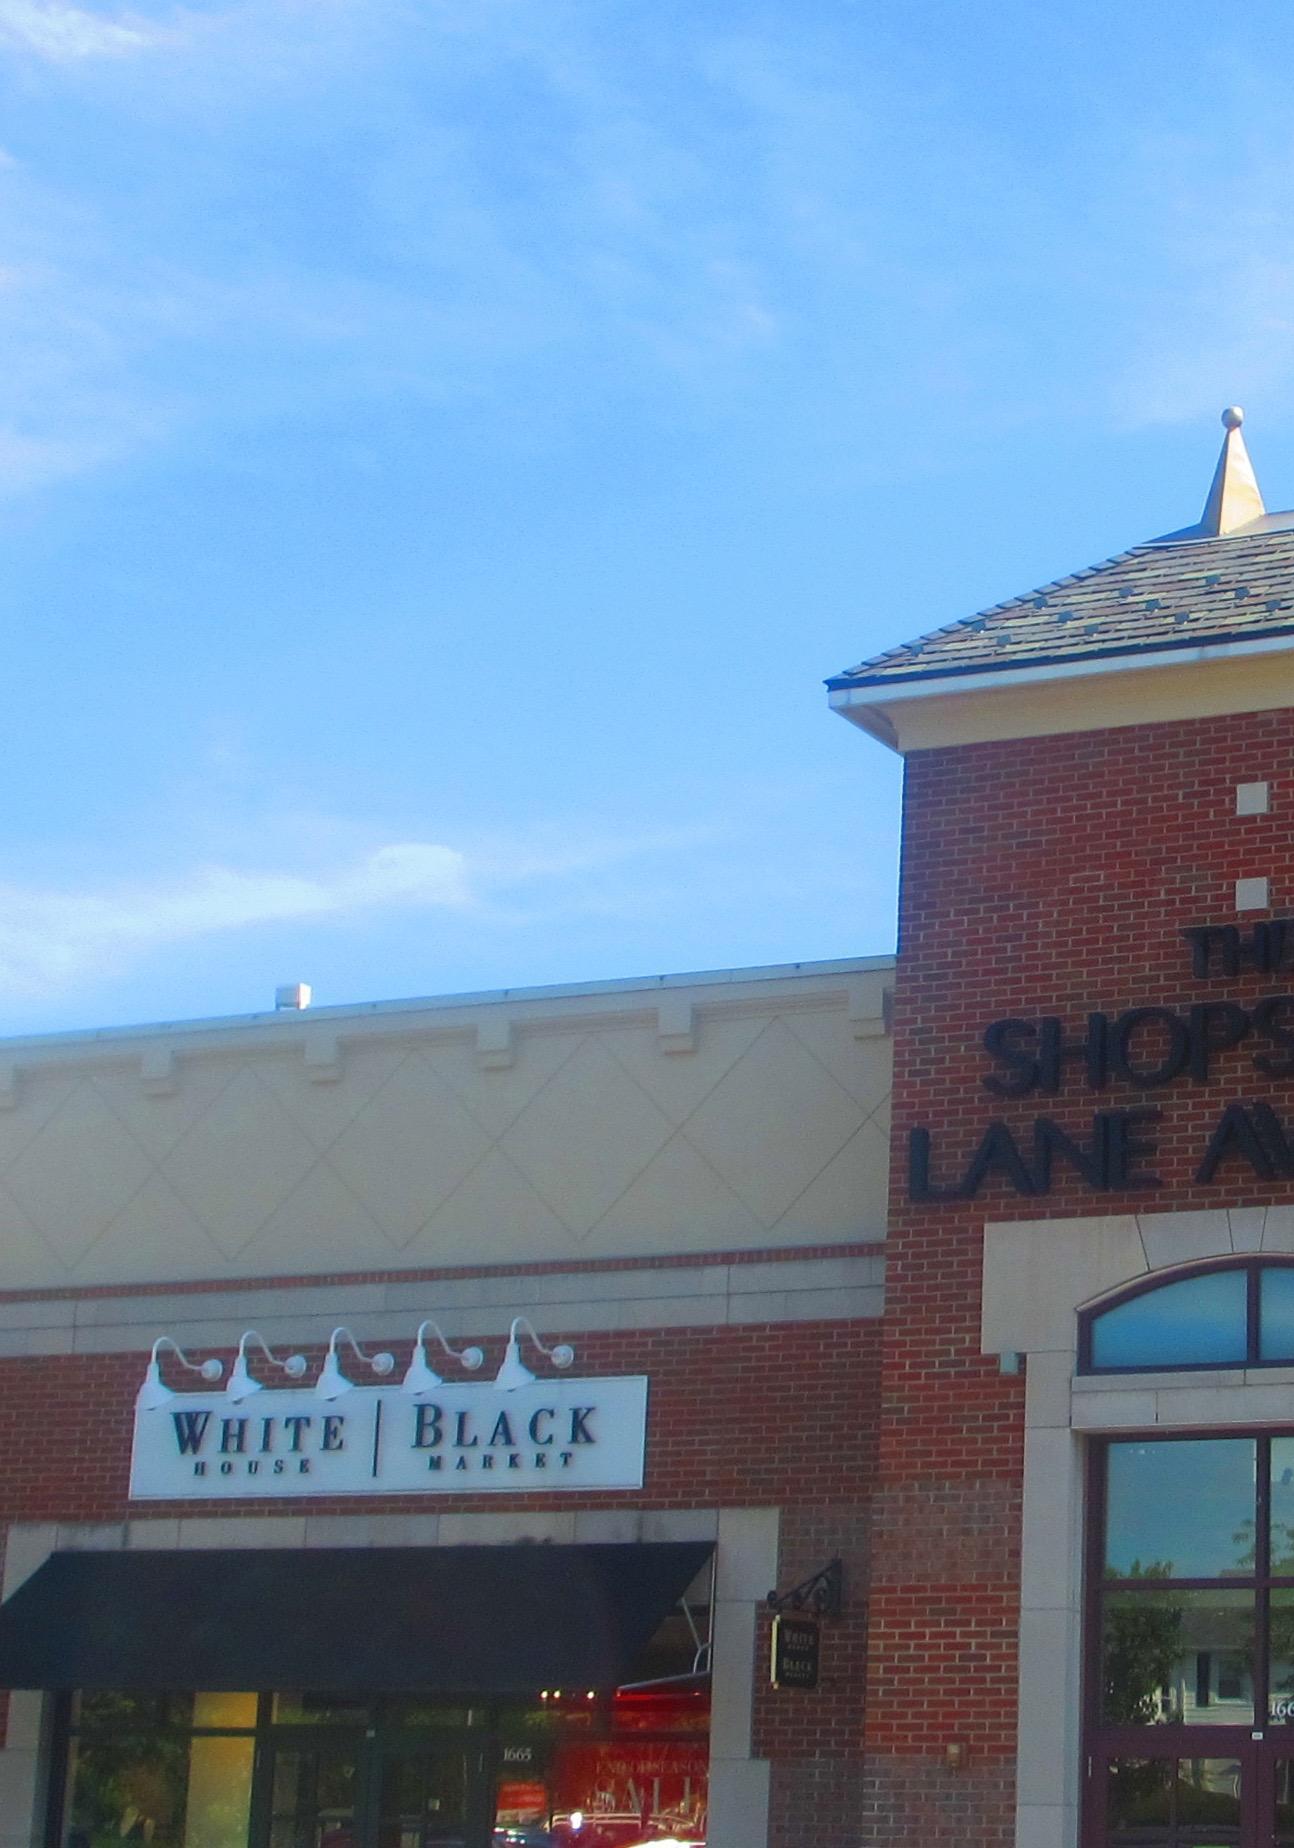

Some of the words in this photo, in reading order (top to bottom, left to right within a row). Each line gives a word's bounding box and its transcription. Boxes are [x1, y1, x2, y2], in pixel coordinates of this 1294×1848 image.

[908, 1108, 1164, 1201] LANE
[171, 1410, 345, 1456] WHITE
[410, 1402, 598, 1450] BLACK
[193, 1458, 311, 1477] HOUSE
[427, 1451, 574, 1471] MARKET
[503, 1747, 532, 1762] 1665
